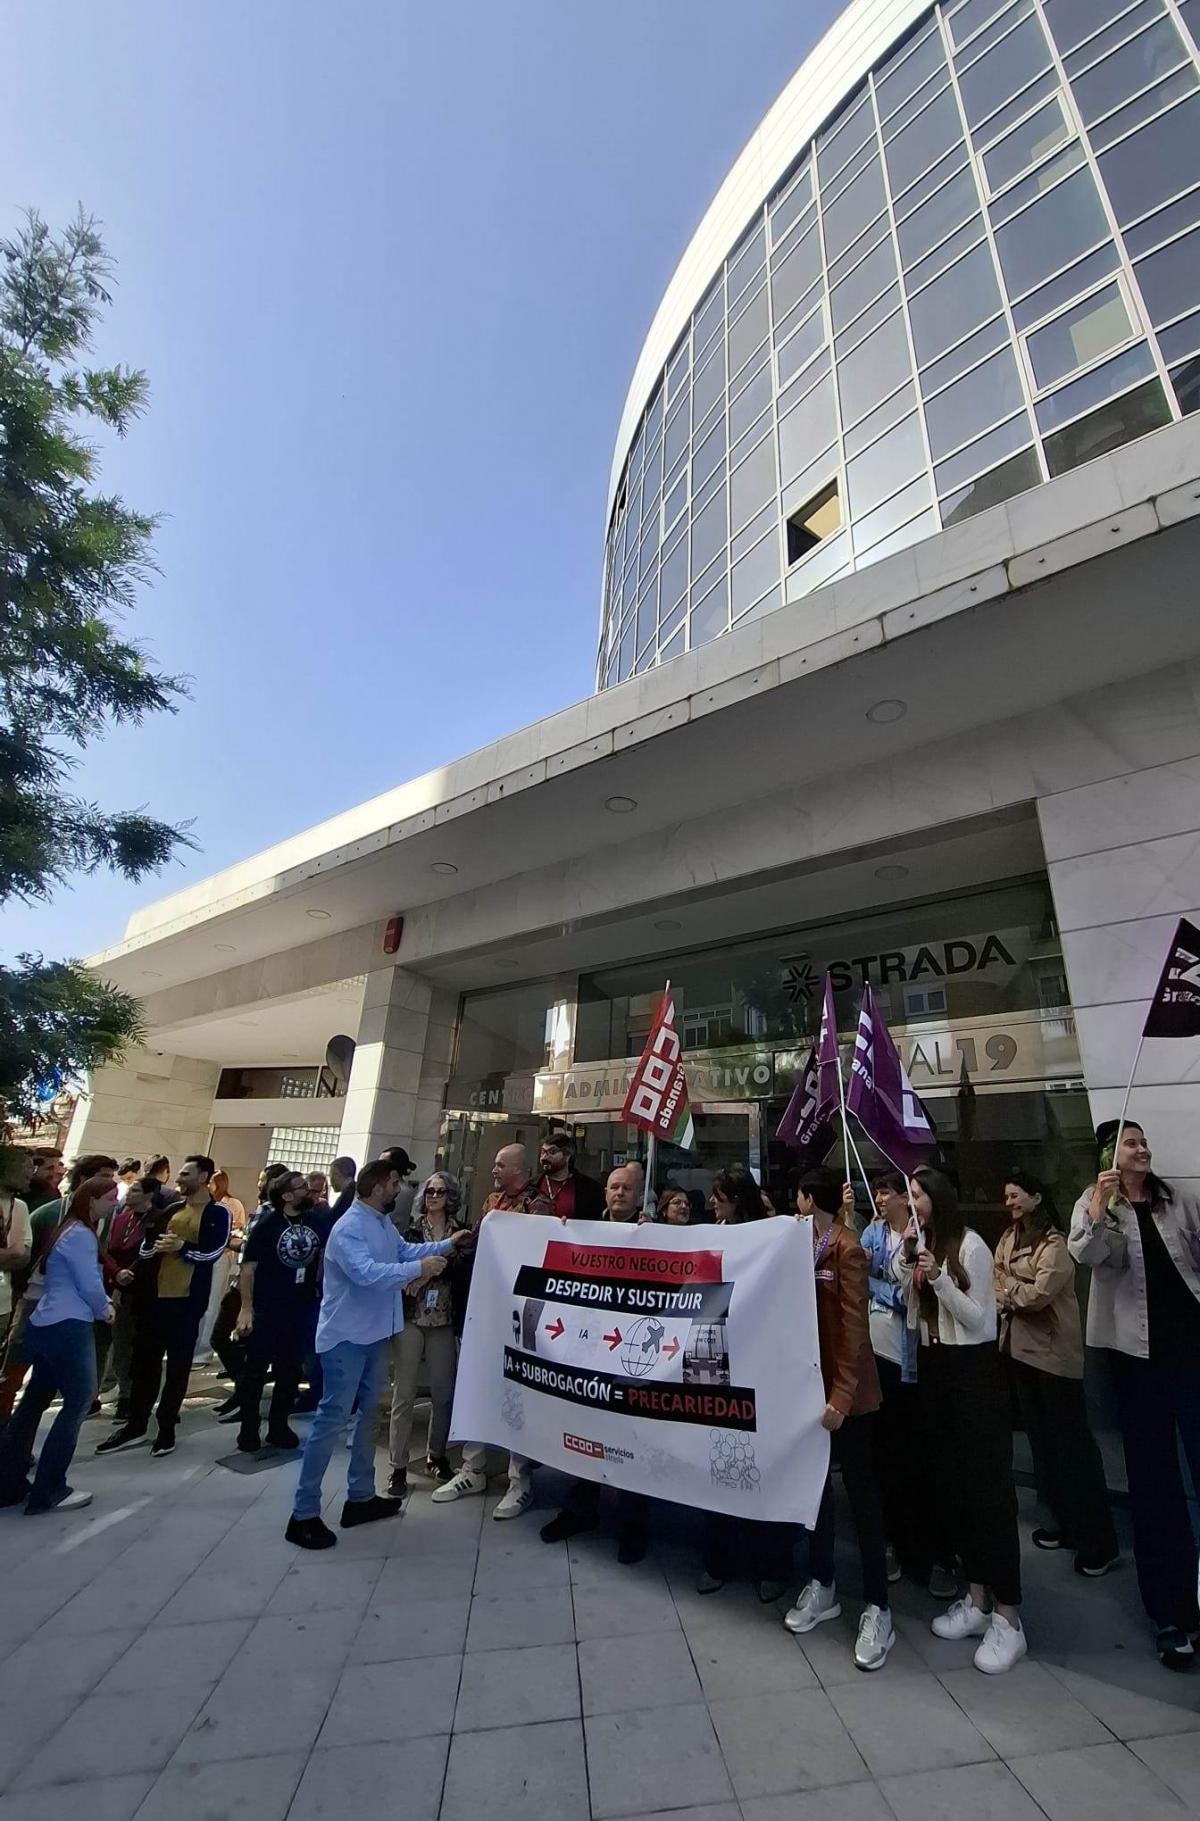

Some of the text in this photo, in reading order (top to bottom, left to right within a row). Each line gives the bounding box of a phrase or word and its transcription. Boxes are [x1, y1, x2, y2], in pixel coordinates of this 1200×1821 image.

[826, 934, 1016, 992] STRADA
[956, 1034, 1018, 1073] 19
[571, 1251, 697, 1275] VUESTRO NEGOCIO:
[545, 1278, 703, 1310] DESPEDIR Y SUSTITUIR
[578, 1328, 589, 1340] IA
[504, 1354, 514, 1372] IA
[522, 1361, 611, 1402] SUBROGACIÓN
[628, 1388, 755, 1420] PRECARIEDAD
[565, 1434, 634, 1460] CCOO servicios
